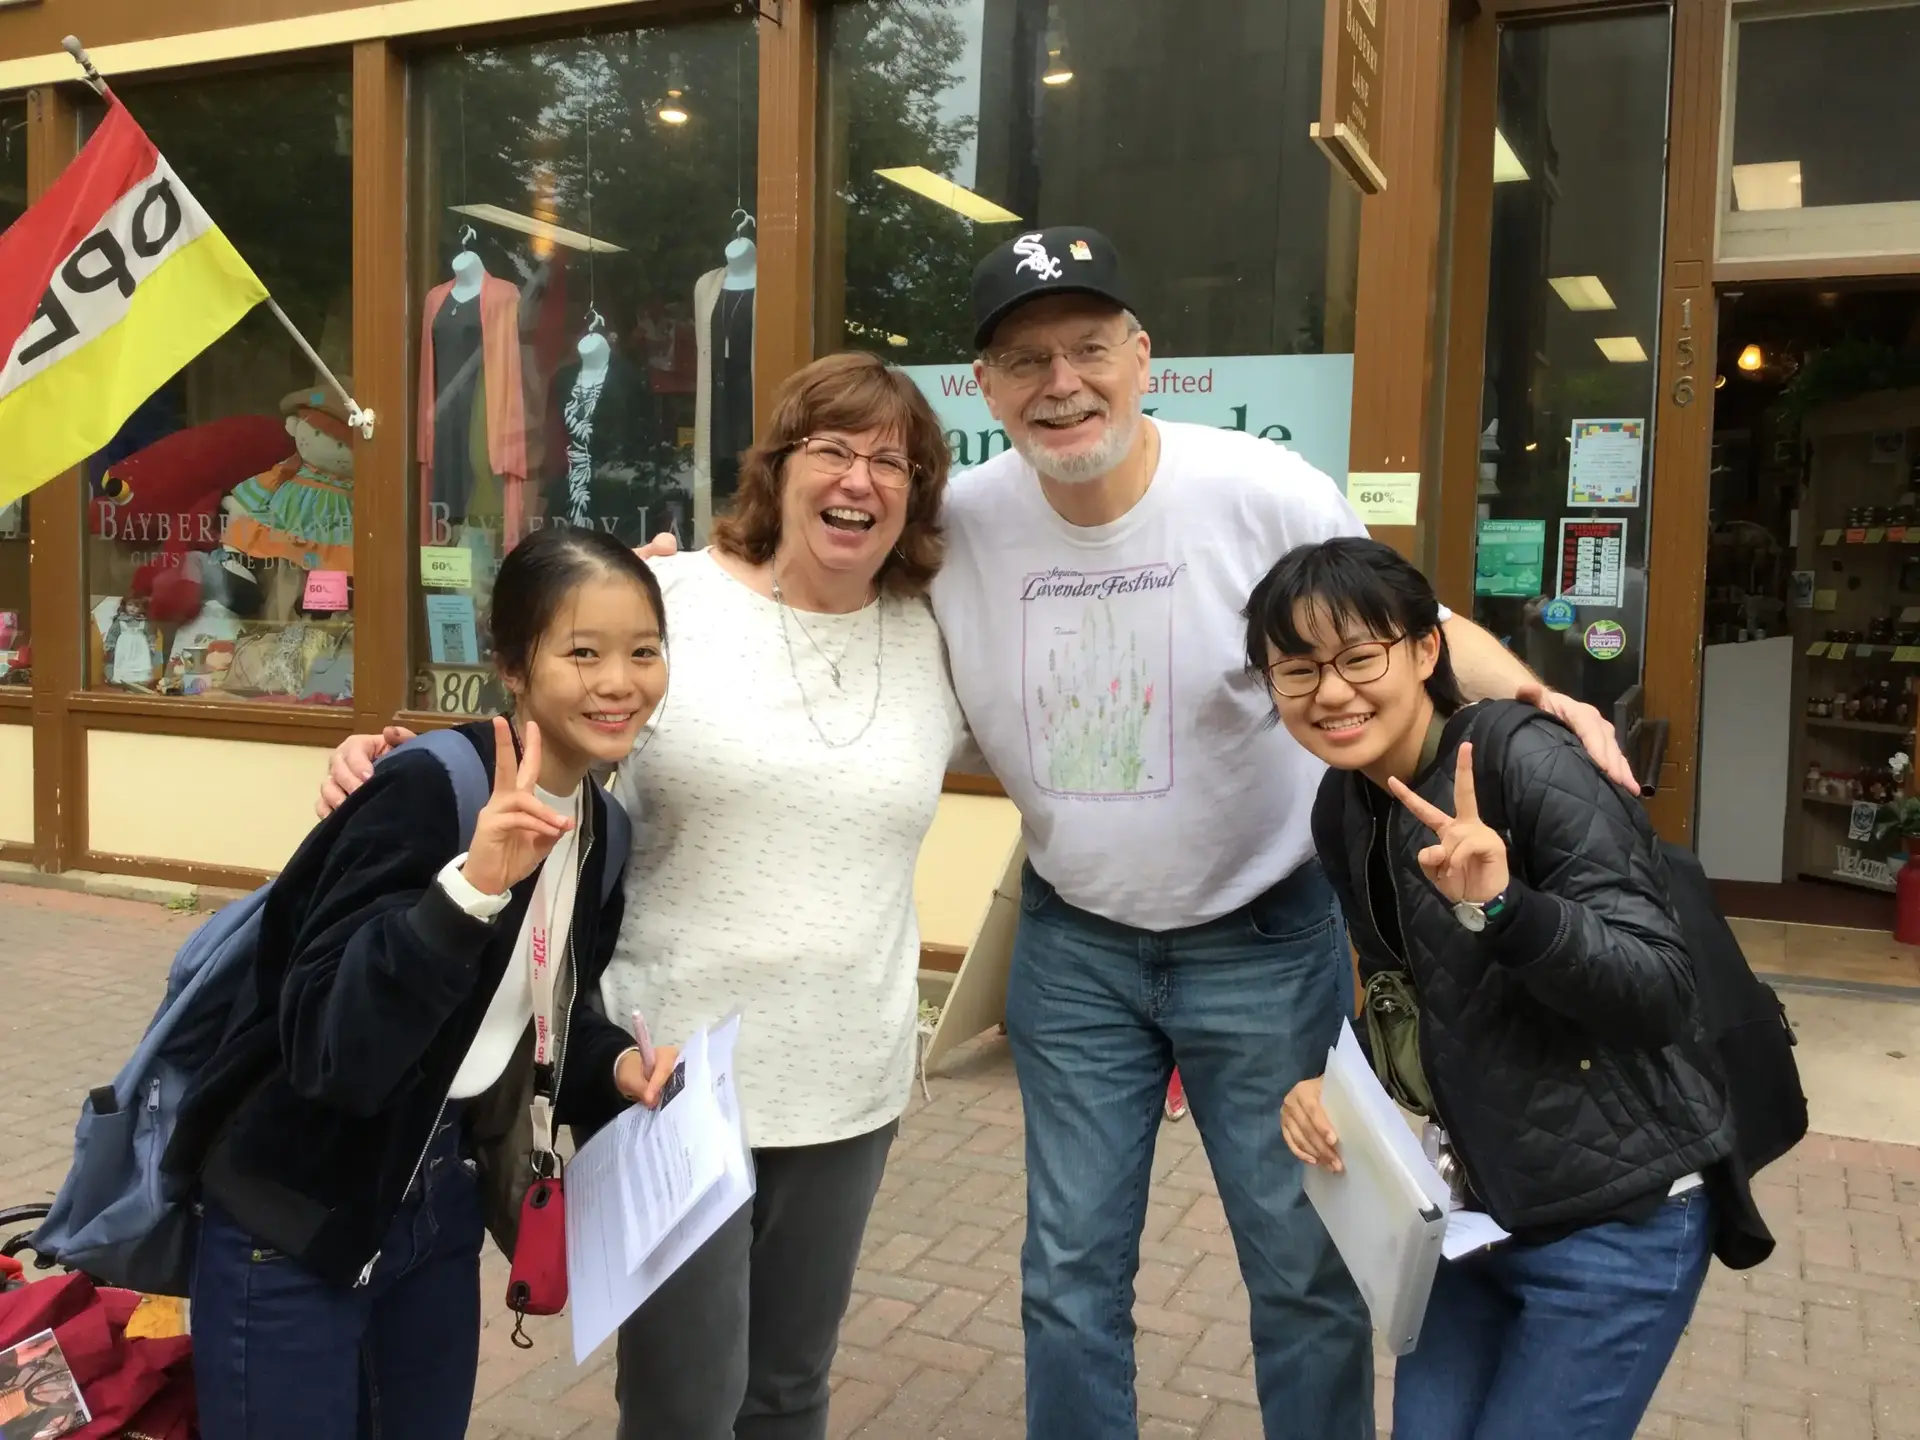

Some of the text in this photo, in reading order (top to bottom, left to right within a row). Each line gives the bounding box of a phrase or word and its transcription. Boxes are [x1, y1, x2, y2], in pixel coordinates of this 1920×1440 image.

[1675, 298, 1695, 406] 156
[940, 374, 978, 397] We
[1360, 491, 1395, 504] 60%
[98, 501, 236, 542] BAYBER
[428, 501, 620, 547] BAYEY
[130, 551, 180, 569] GIFTS
[1019, 563, 1187, 601] Lavender Festival
[537, 1015, 548, 1044] niko
